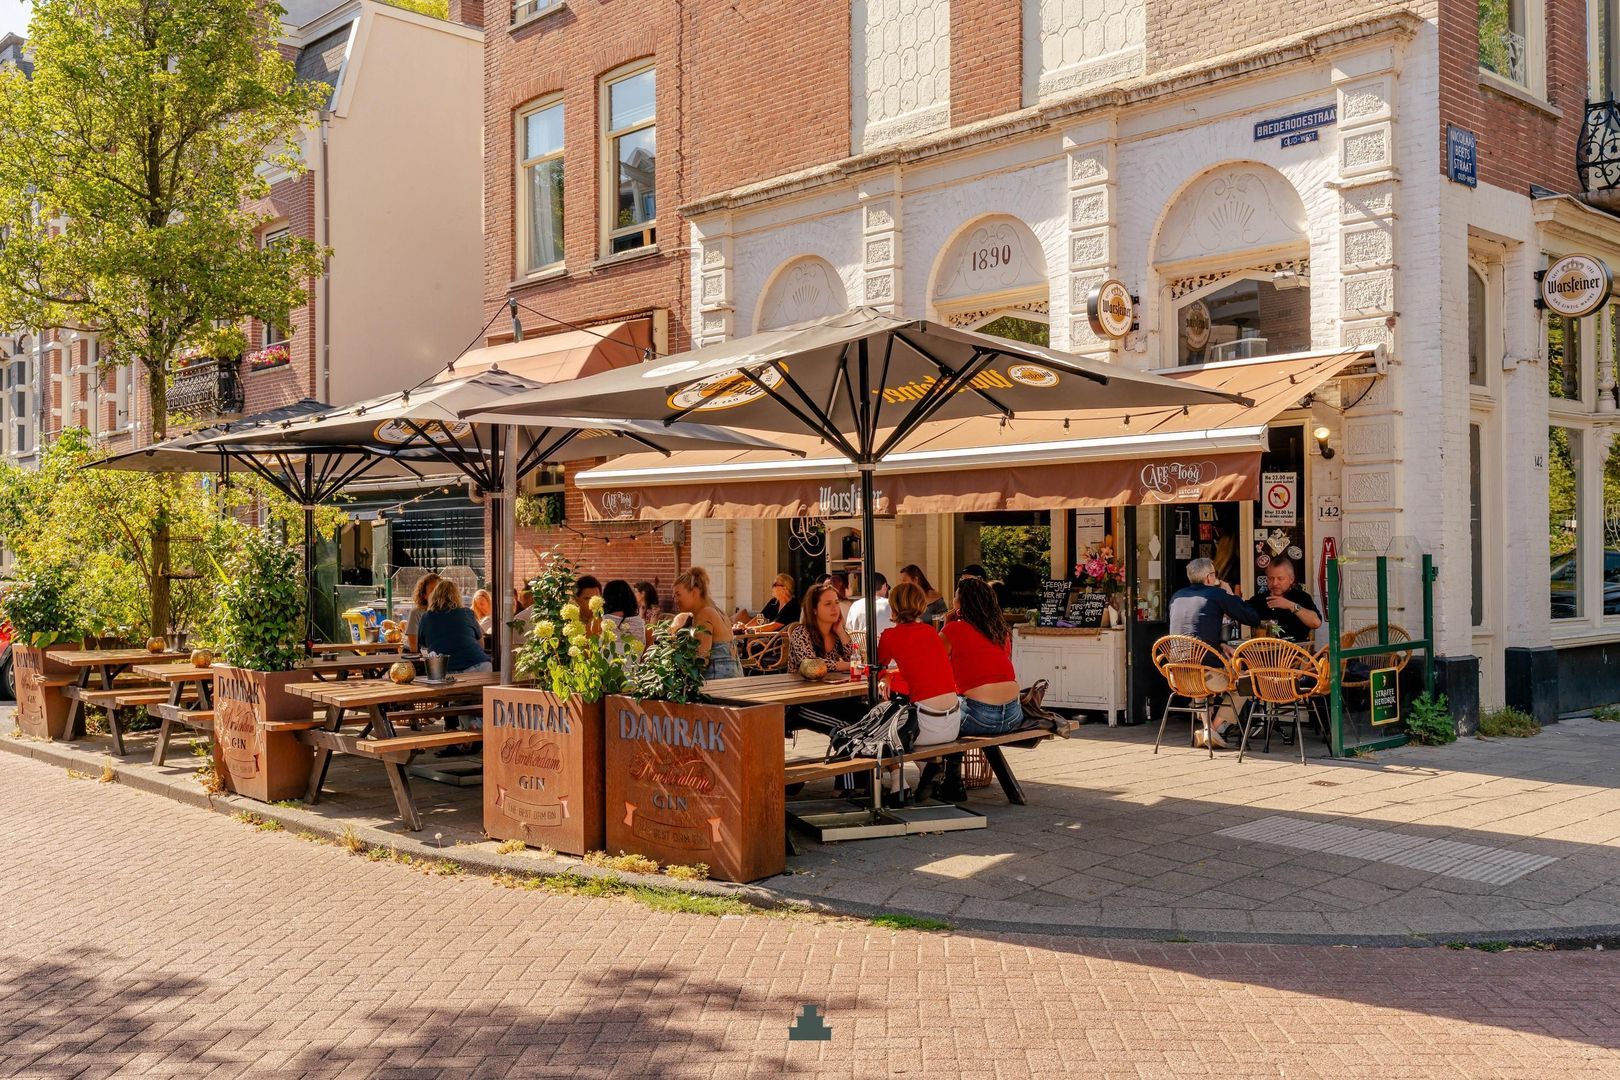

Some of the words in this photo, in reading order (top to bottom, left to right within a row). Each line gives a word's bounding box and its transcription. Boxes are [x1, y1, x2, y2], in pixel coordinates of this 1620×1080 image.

[1453, 158, 1473, 174] STRAAT
[972, 244, 1011, 271] 1890
[1547, 276, 1600, 294] Warsteiner
[1102, 299, 1131, 317] Warsteiner
[1535, 455, 1543, 467] 142
[1319, 506, 1340, 517] 142
[218, 675, 260, 705] DAMRAK
[492, 698, 572, 734] DAMRAK
[619, 709, 726, 753] DAMRAK
[231, 737, 247, 750] GIN
[501, 736, 564, 773] Amsterdam
[518, 775, 546, 792] GIN
[652, 792, 689, 812] GIN
[519, 809, 531, 818] BEST
